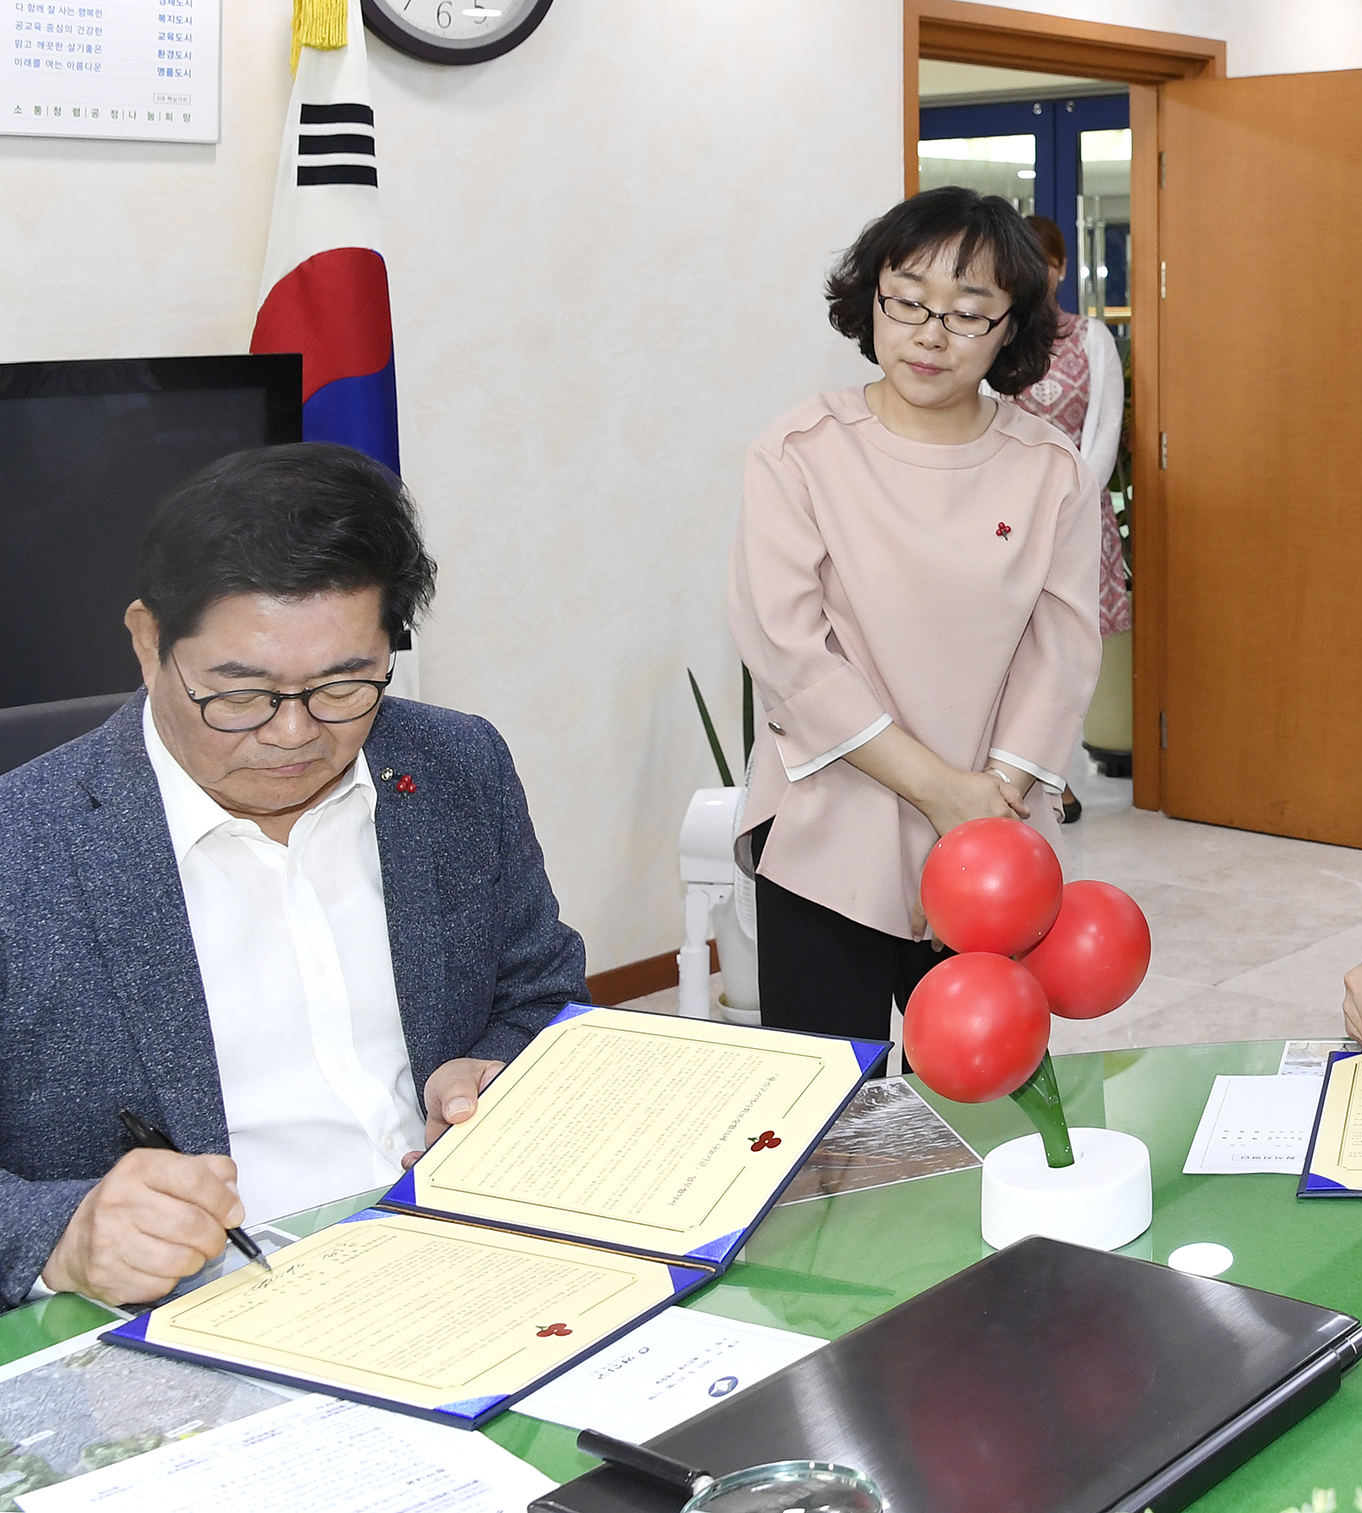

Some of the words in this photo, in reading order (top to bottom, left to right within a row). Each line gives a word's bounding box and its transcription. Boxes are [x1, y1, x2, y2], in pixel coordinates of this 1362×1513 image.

[15, 2, 24, 12] 다
[27, 3, 45, 14] 함께
[48, 5, 56, 15] 잘
[58, 6, 75, 16] 사는
[78, 7, 103, 19] 행복한
[158, 13, 192, 25] 복지도시
[437, 1, 452, 29] 6
[15, 20, 42, 32] 공교육
[46, 23, 73, 34] 중심의
[77, 25, 103, 37] 건강한
[158, 32, 192, 43] 교육도시
[14, 39, 32, 49] 맑고
[37, 41, 63, 52] 깨끗한
[67, 43, 102, 54] 살기좋은
[157, 49, 192, 60] 환경도시
[14, 58, 41, 69] 미래를
[45, 60, 63, 70] 여는
[67, 62, 102, 72] 아름다운
[157, 67, 192, 79] 명품도시
